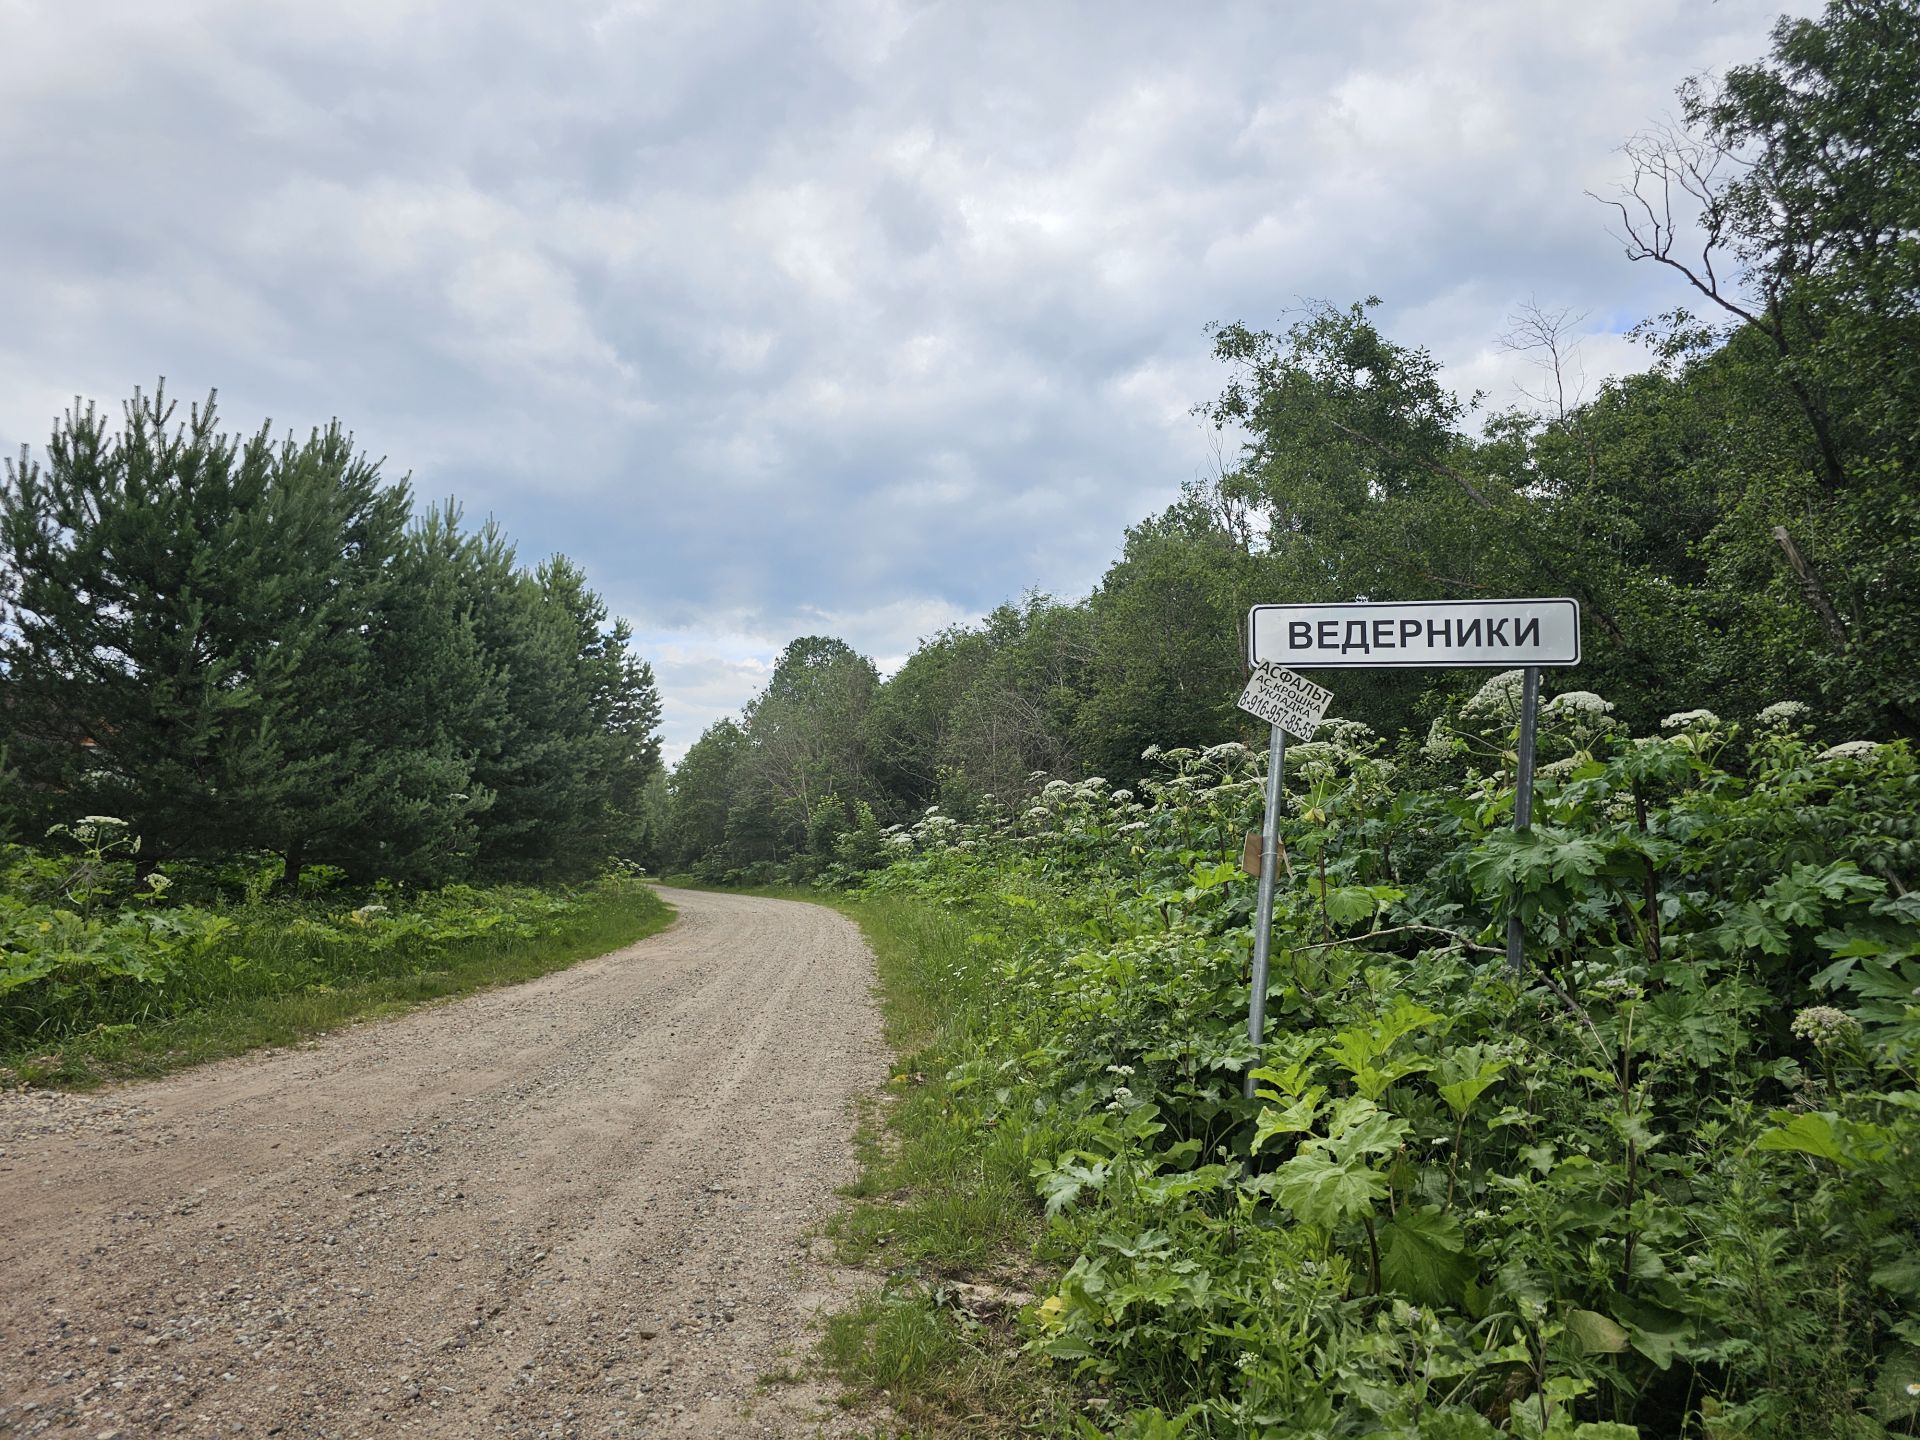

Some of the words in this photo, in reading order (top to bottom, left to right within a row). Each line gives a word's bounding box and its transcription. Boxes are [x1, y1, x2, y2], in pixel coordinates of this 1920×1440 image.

[1289, 618, 1540, 654] ВЕДЕРНИКИ
[1258, 661, 1332, 704] АСФАЛЬТ
[1258, 686, 1310, 718] УКЛАДКА
